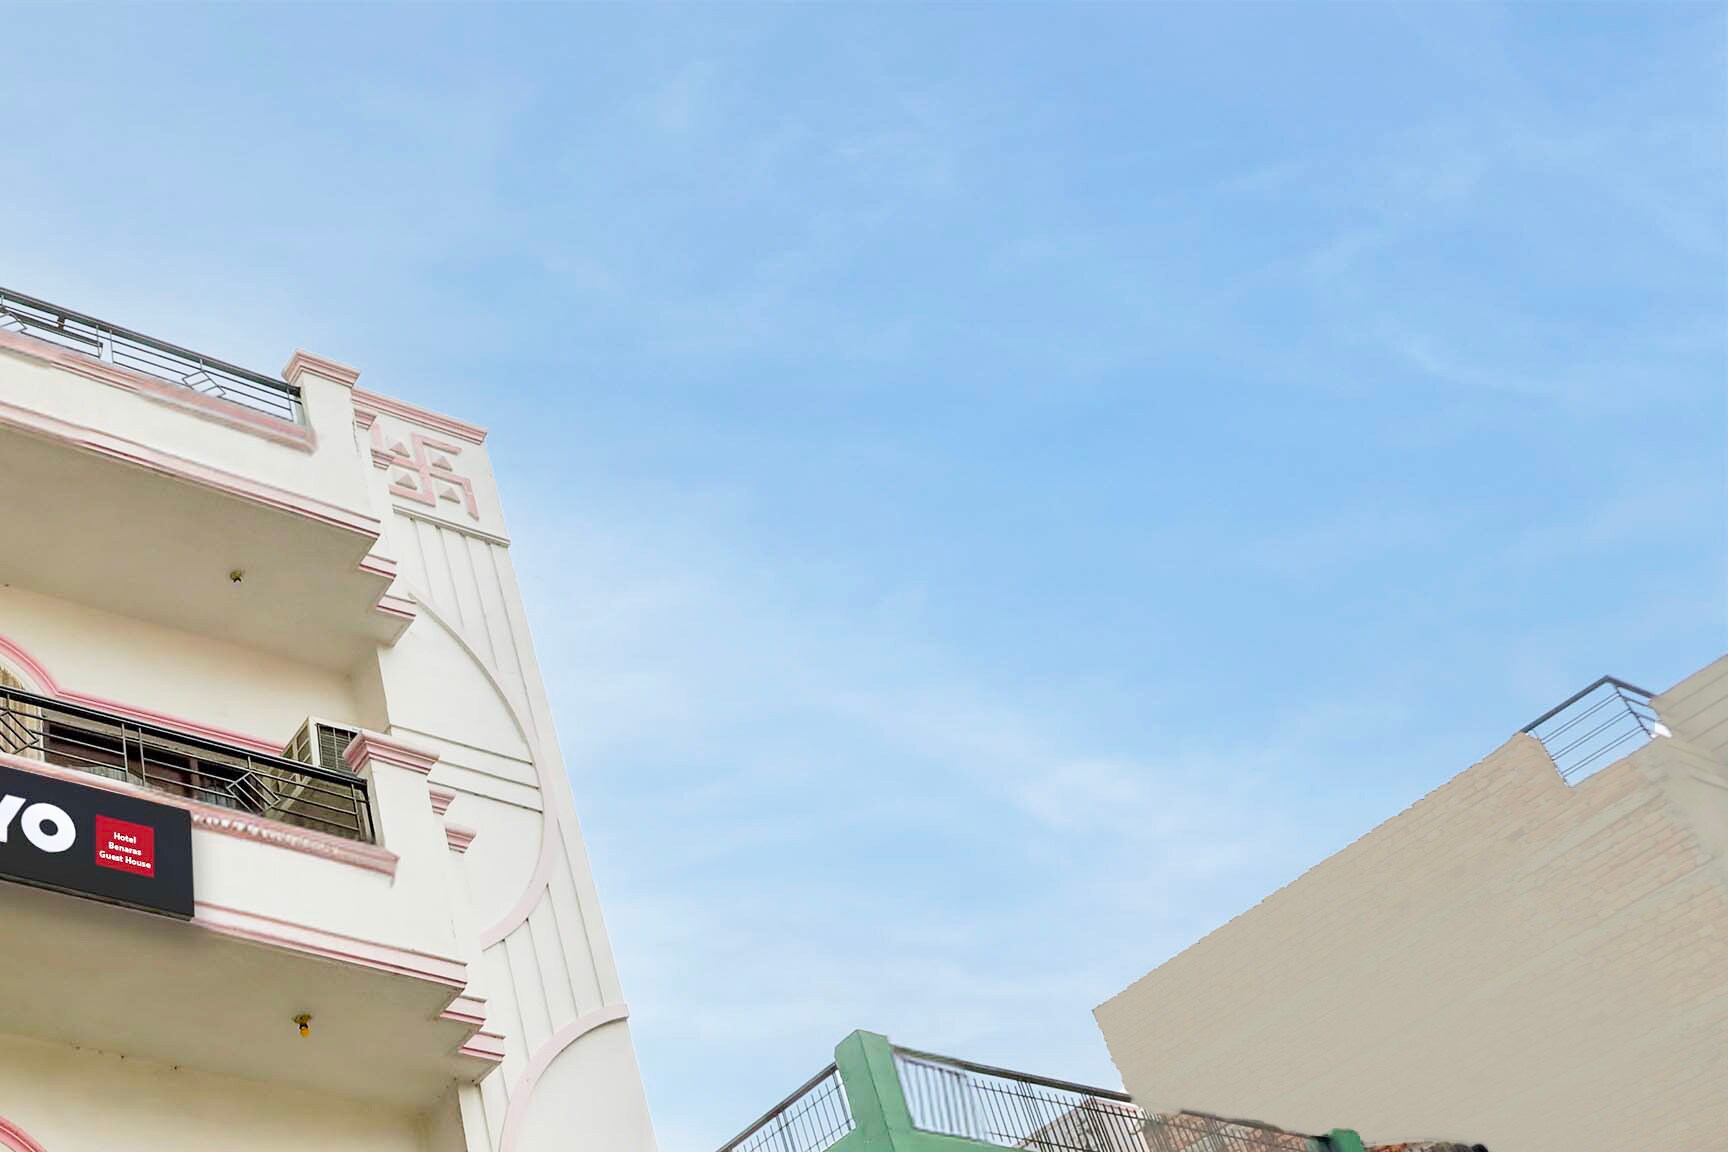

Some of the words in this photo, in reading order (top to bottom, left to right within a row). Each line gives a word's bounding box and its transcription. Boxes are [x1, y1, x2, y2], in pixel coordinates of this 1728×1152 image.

[113, 831, 137, 844] Hotel
[108, 841, 142, 856] Benaras
[99, 850, 124, 862] Guest
[125, 856, 152, 869] House
